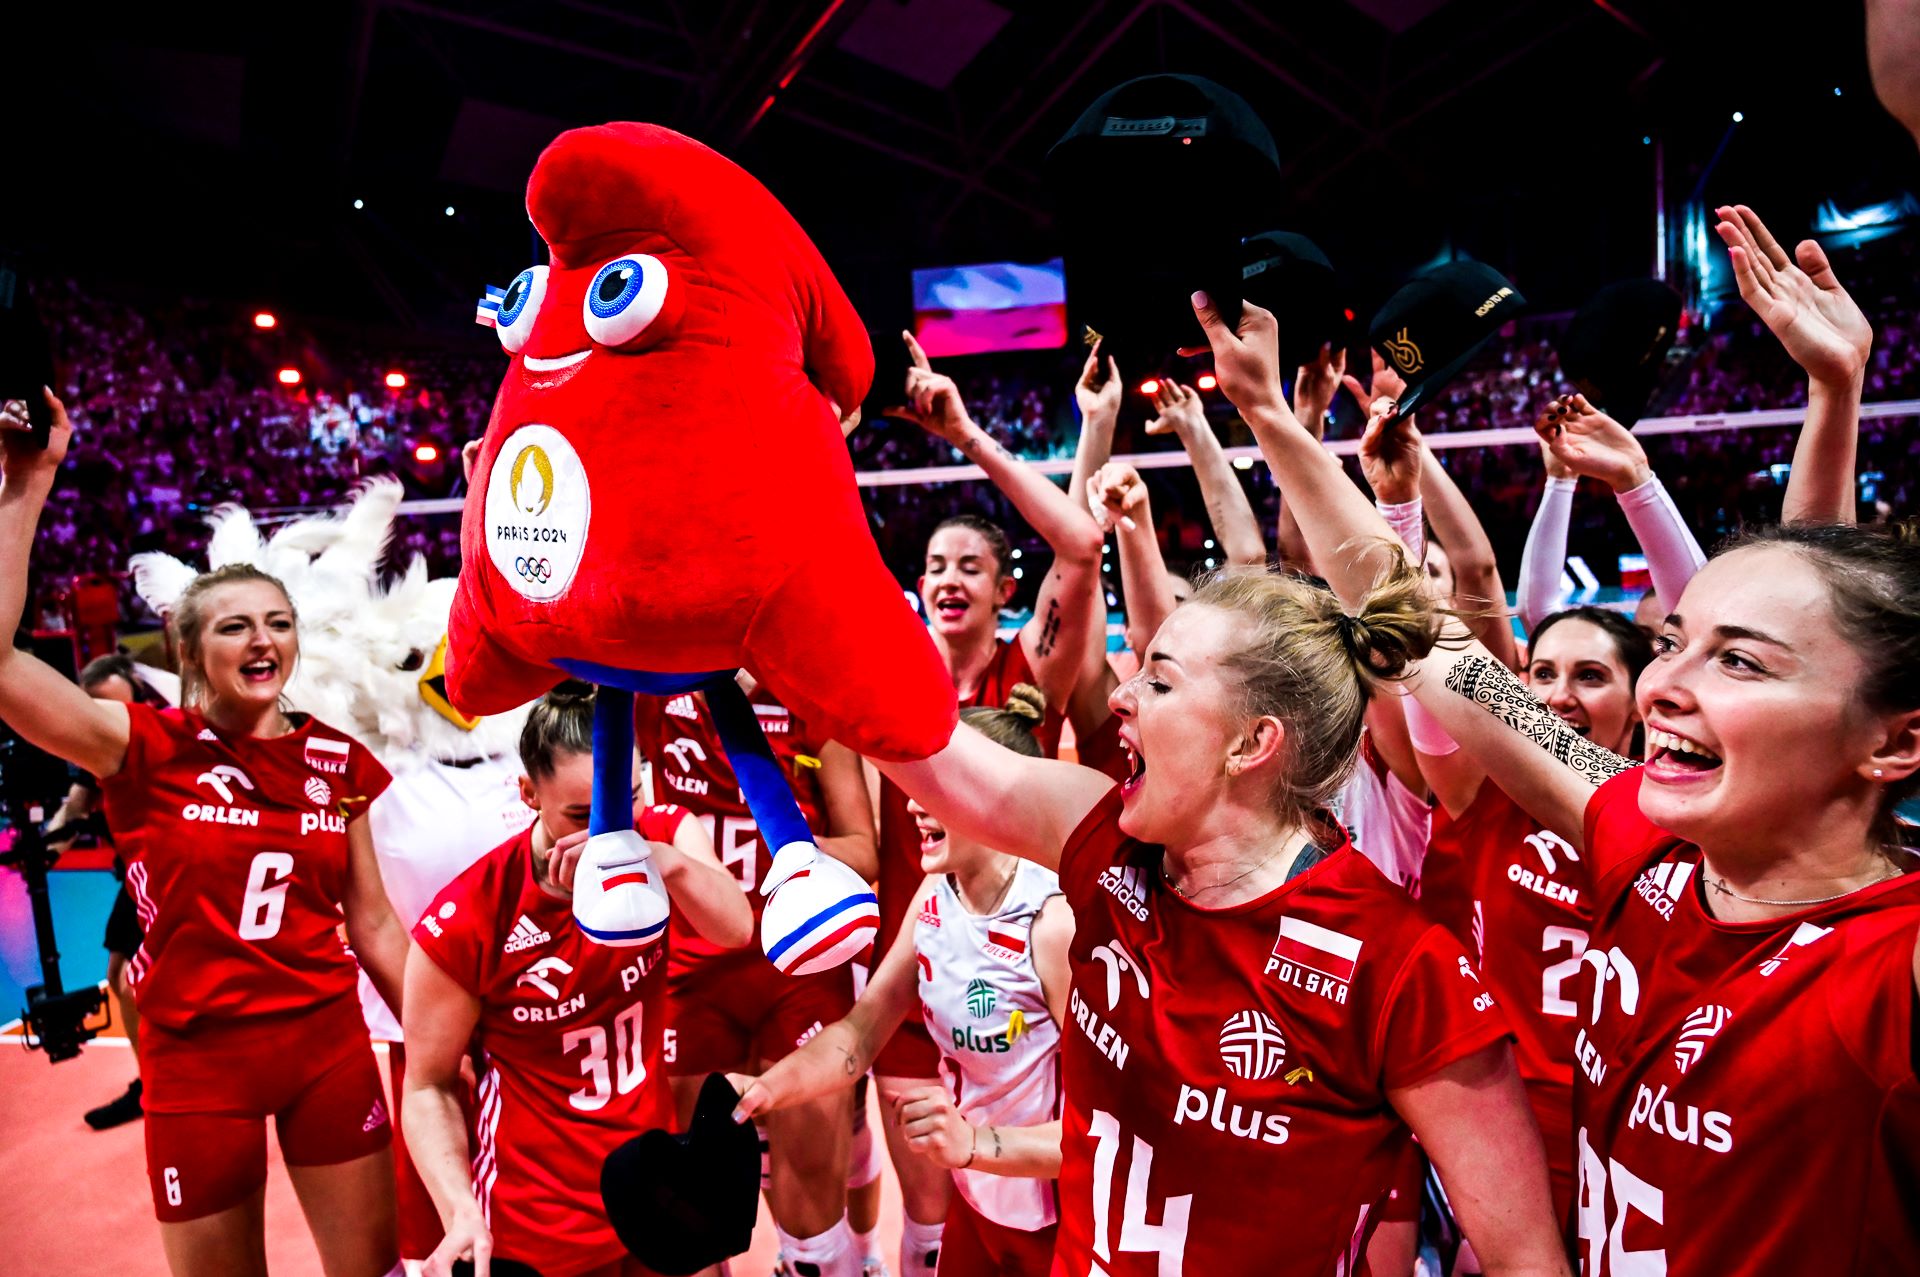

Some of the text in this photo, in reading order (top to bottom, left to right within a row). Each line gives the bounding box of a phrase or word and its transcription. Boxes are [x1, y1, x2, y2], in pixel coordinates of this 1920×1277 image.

[533, 527, 567, 543] 2024
[760, 721, 789, 733] LSKA
[182, 803, 260, 827] ORLEN
[300, 809, 346, 836] plus
[238, 851, 294, 941] 6
[1097, 870, 1150, 922] adidas
[1507, 863, 1579, 905] ORLEN
[420, 914, 444, 938] plus
[504, 931, 551, 953] adidas
[620, 942, 663, 993] plus
[981, 943, 1022, 963] POLSKA
[1263, 956, 1349, 1005] POLSKA
[512, 992, 586, 1022] ORLEN
[952, 1025, 1011, 1053] plus
[1070, 987, 1130, 1071] ORLEN
[562, 1000, 647, 1112] 30
[1574, 1028, 1608, 1087] LEN
[1173, 1083, 1293, 1146] plus
[1627, 1083, 1734, 1154] plus
[163, 1166, 182, 1207] 6
[1086, 1108, 1194, 1277] 14
